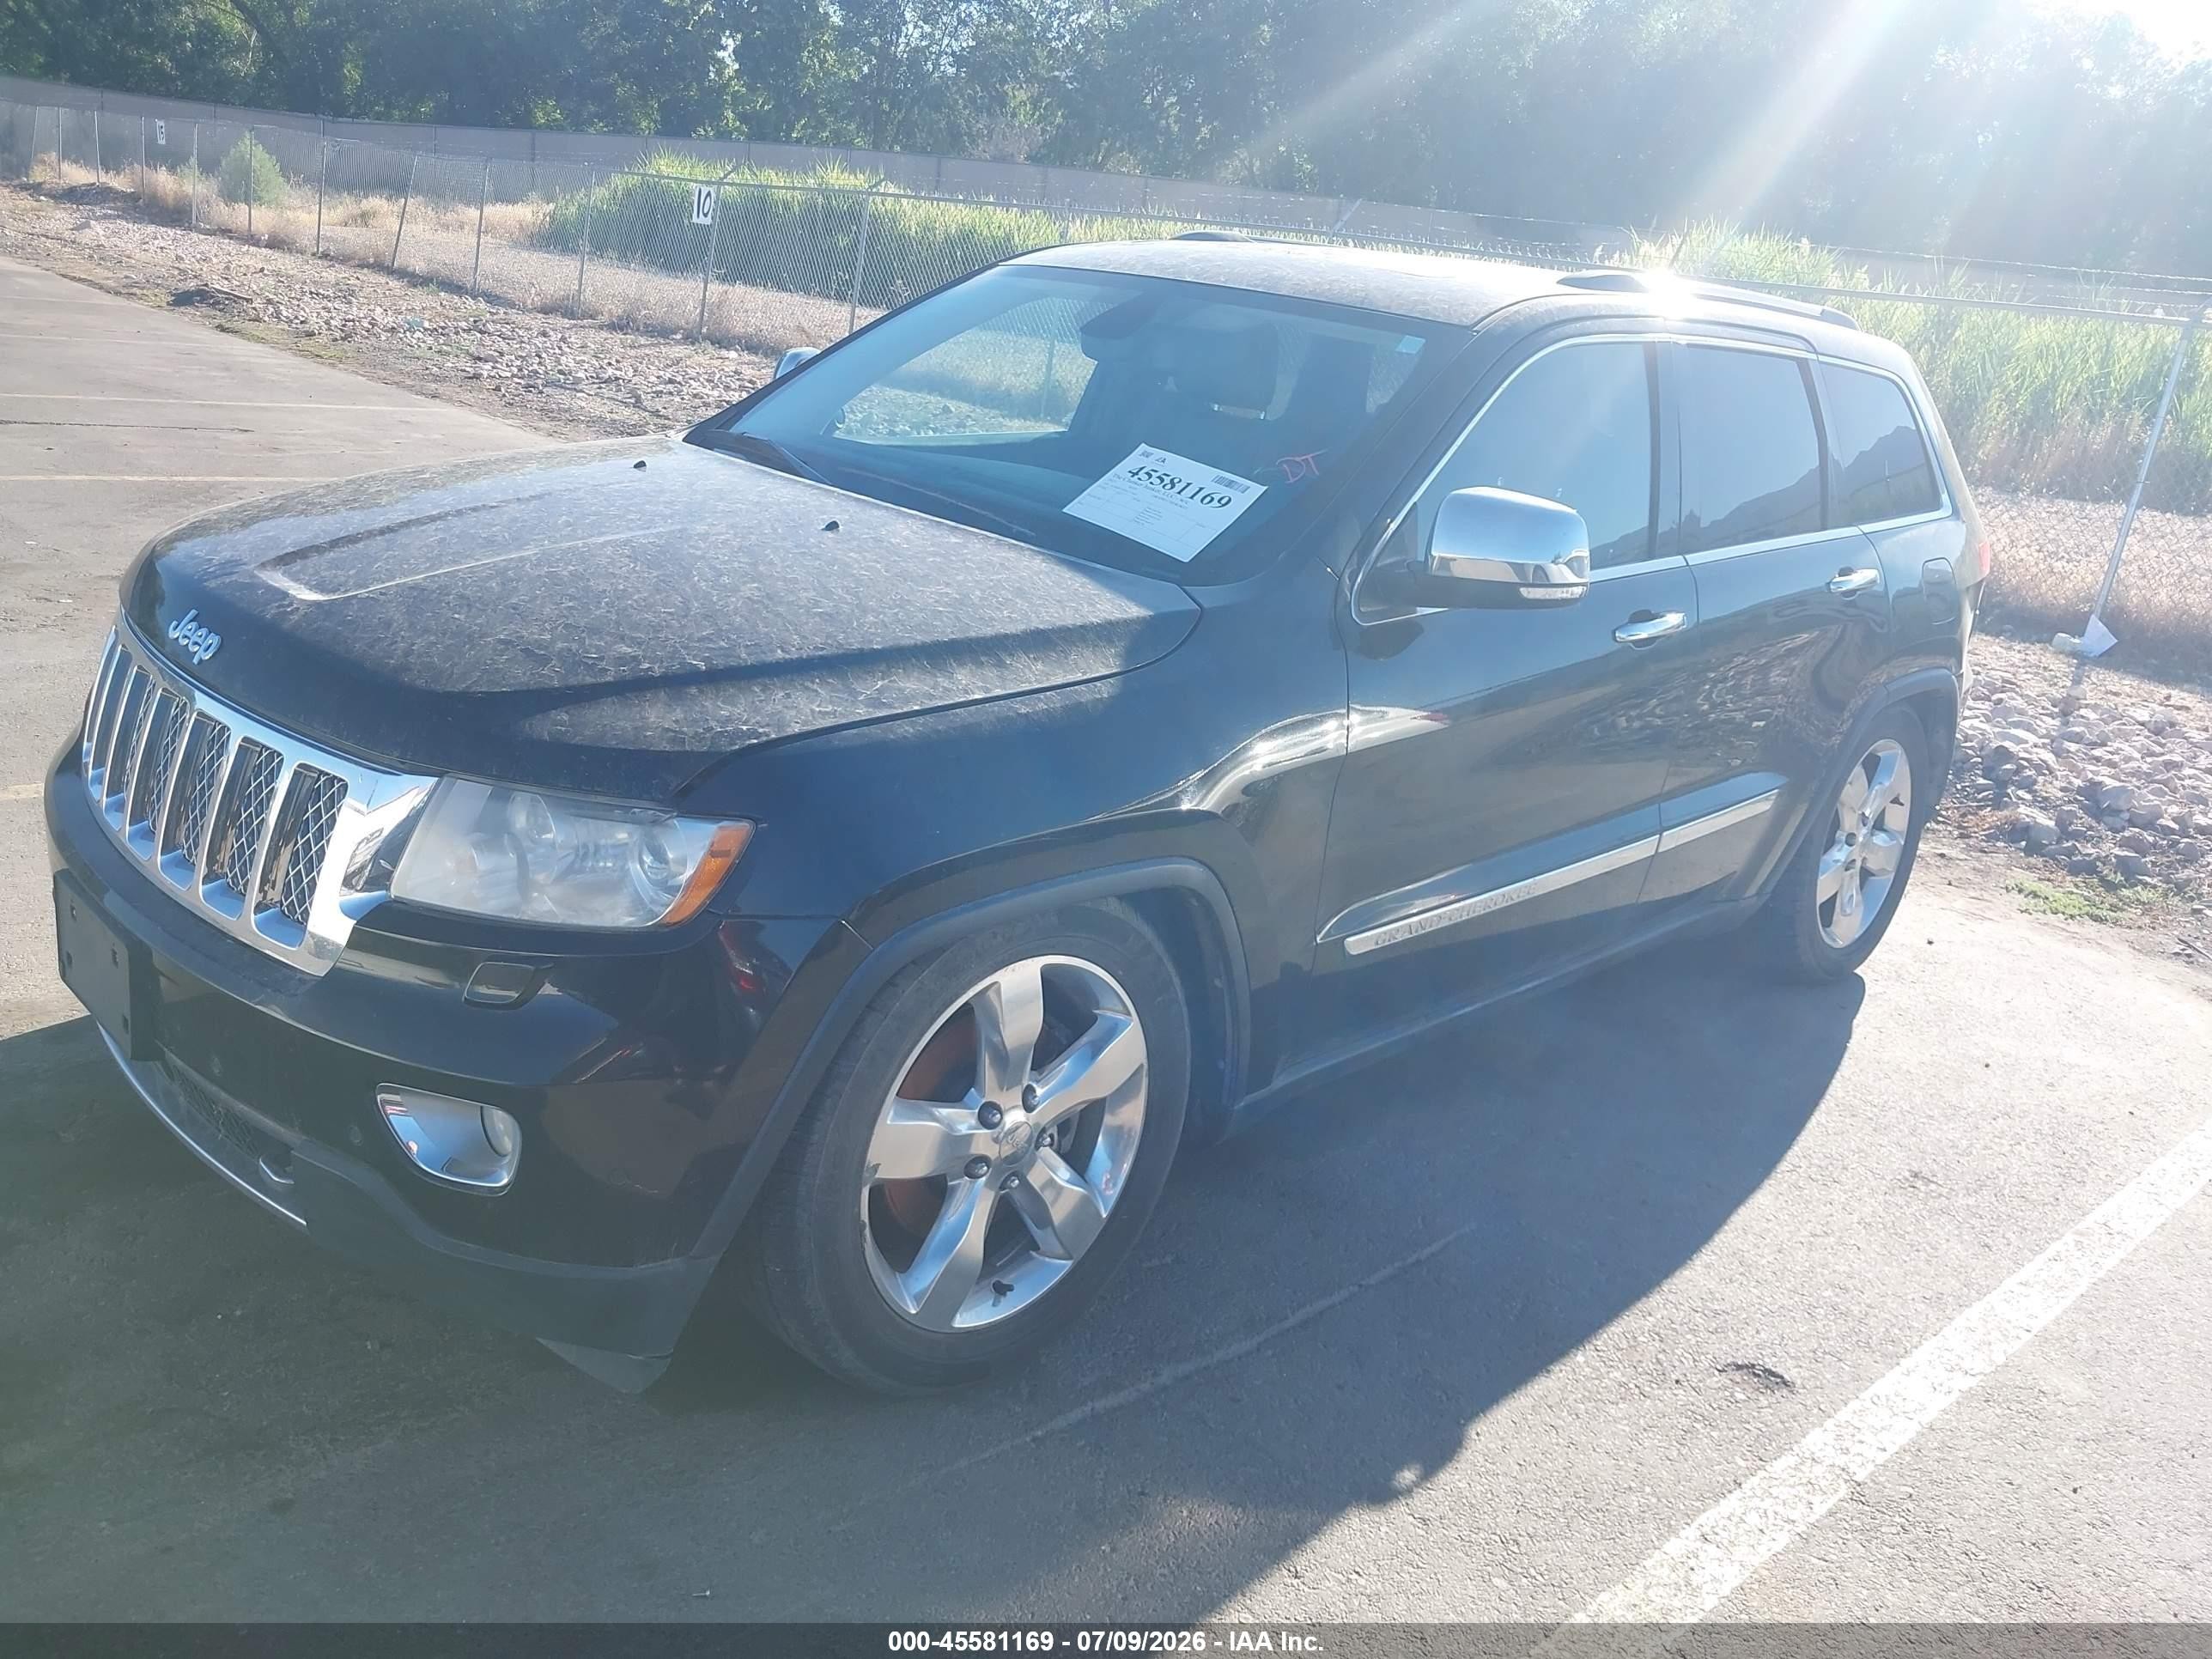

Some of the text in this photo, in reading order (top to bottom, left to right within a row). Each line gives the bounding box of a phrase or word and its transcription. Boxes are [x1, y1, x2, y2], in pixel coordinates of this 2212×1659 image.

[696, 187, 712, 219] 10
[1127, 465, 1232, 508] 45581169
[168, 608, 222, 665] Jeep
